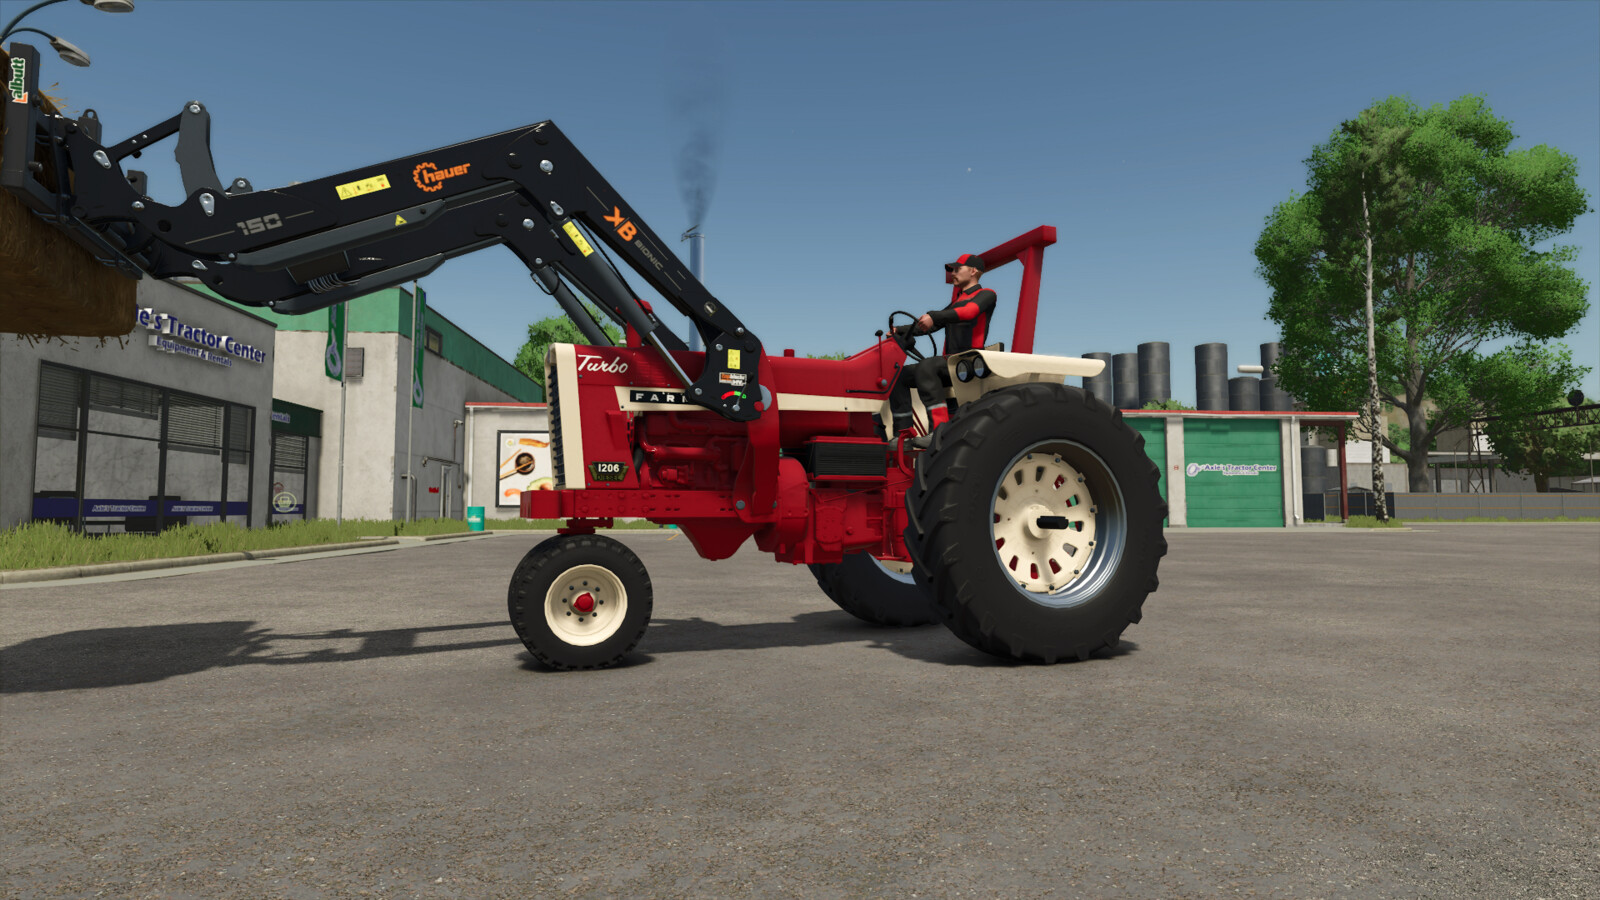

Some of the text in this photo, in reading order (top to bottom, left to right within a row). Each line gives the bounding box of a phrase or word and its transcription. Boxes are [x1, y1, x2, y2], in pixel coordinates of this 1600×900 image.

[10, 58, 25, 98] albutt
[421, 163, 470, 184] hauer
[237, 213, 283, 235] 150
[603, 205, 637, 242] XB
[634, 239, 664, 270] BIONIC
[156, 336, 233, 367] Equipment & Rentals
[168, 316, 222, 348] Tractor
[225, 336, 266, 363] Center
[577, 354, 629, 374] Turbo
[598, 463, 619, 473] 1206
